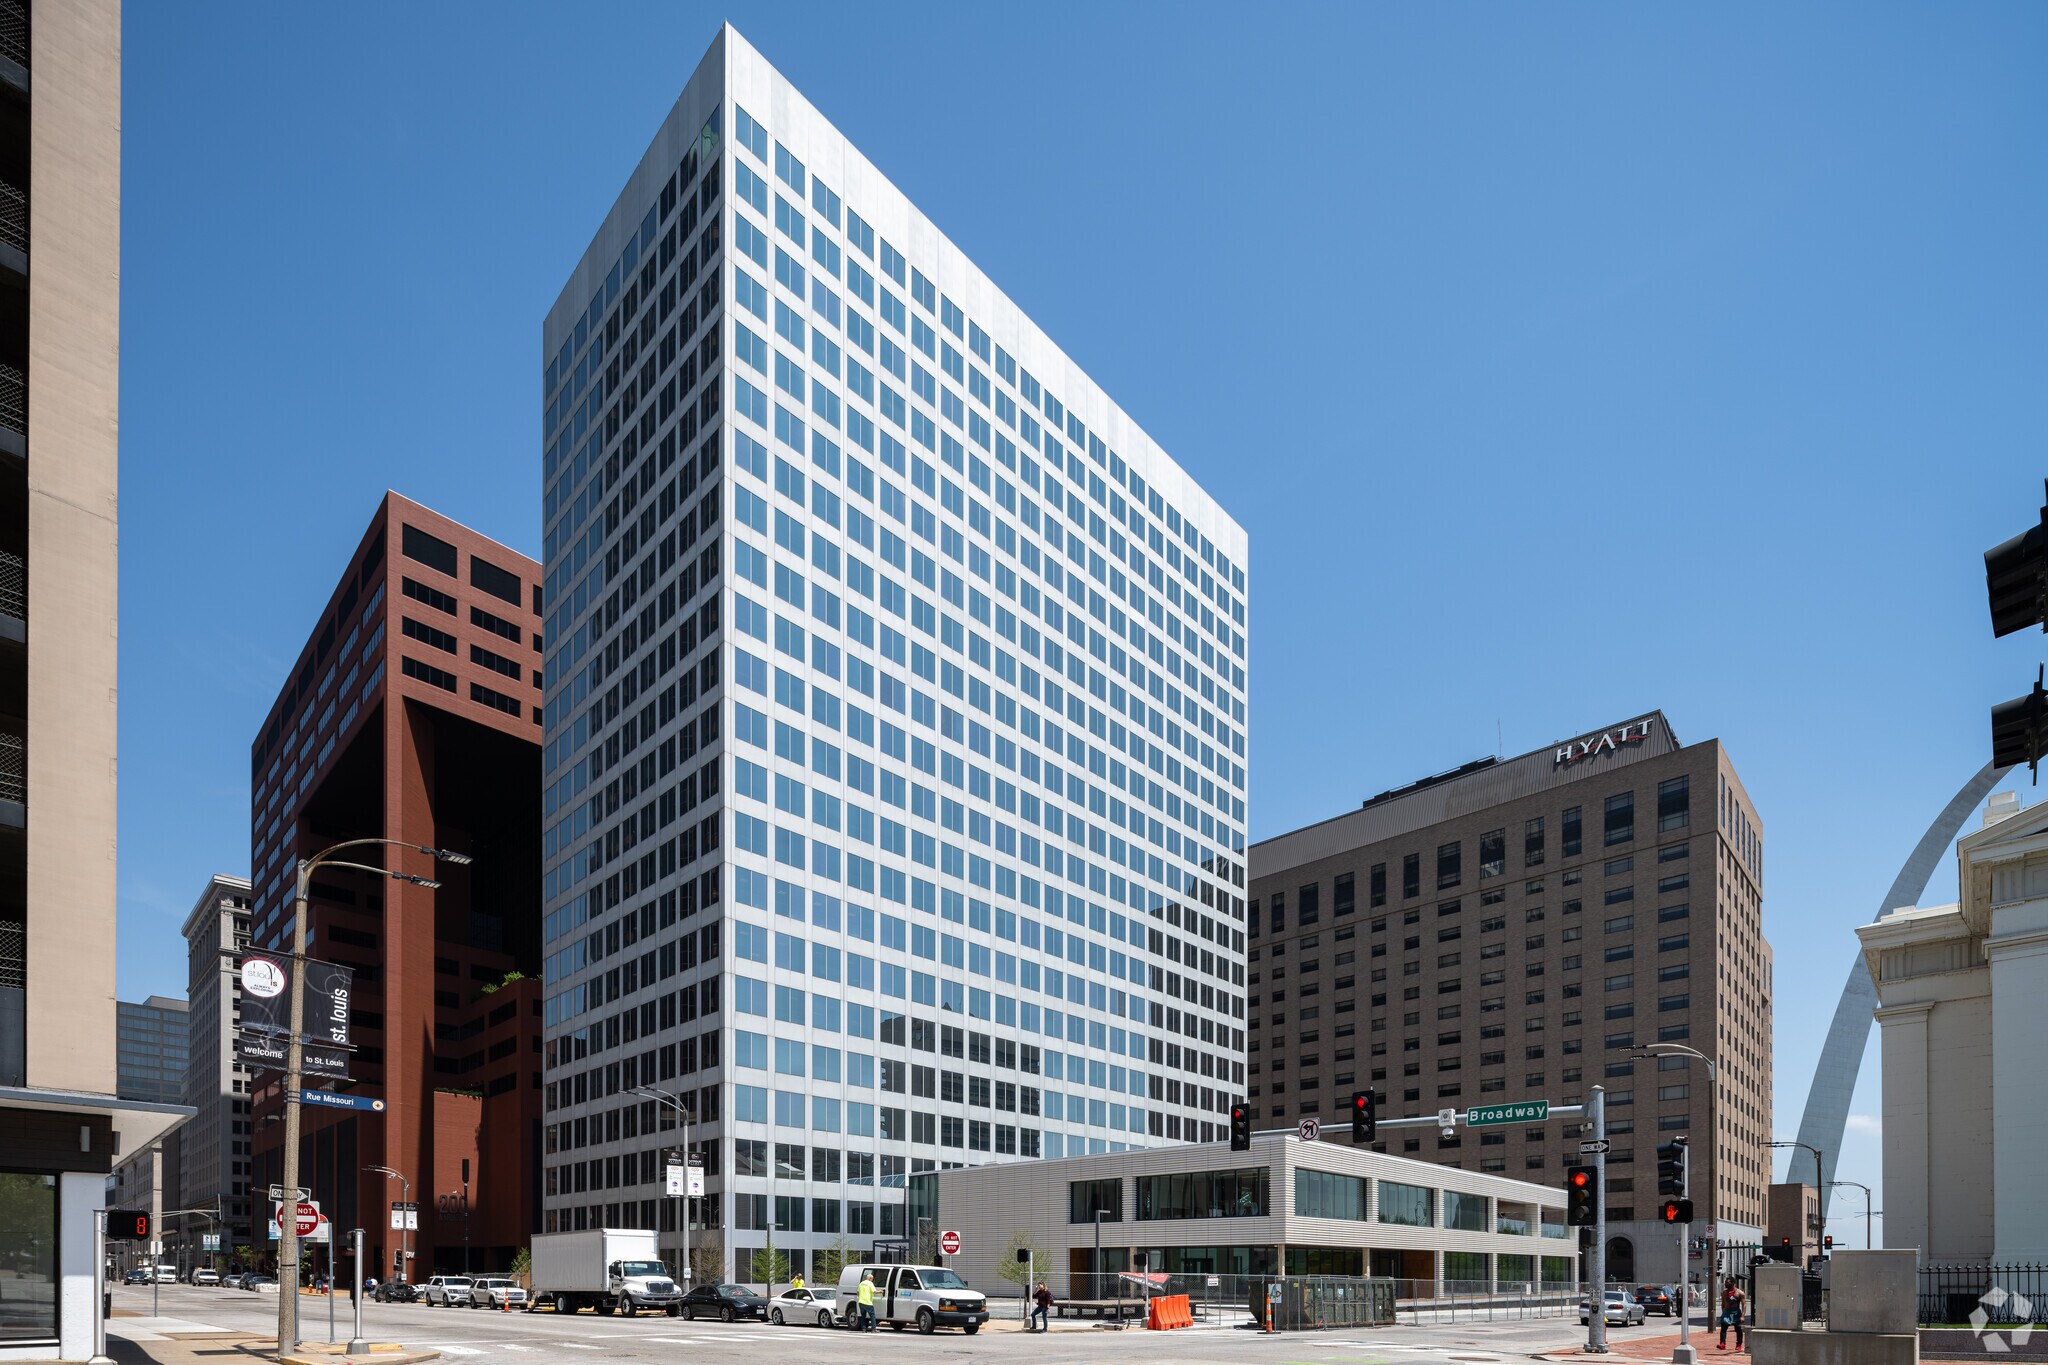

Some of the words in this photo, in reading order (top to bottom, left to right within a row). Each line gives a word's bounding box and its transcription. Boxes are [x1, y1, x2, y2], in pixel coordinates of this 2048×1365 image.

[1556, 719, 1653, 763] HYATT
[330, 988, 348, 1023] louis
[330, 1026, 346, 1042] st.
[244, 1046, 283, 1059] welcome
[314, 1057, 324, 1065] St.
[326, 1059, 344, 1067] Louis
[306, 1093, 321, 1101] Rue
[323, 1094, 354, 1105] Missouri
[1469, 1106, 1545, 1121] Broadway
[137, 1217, 146, 1234] 8
